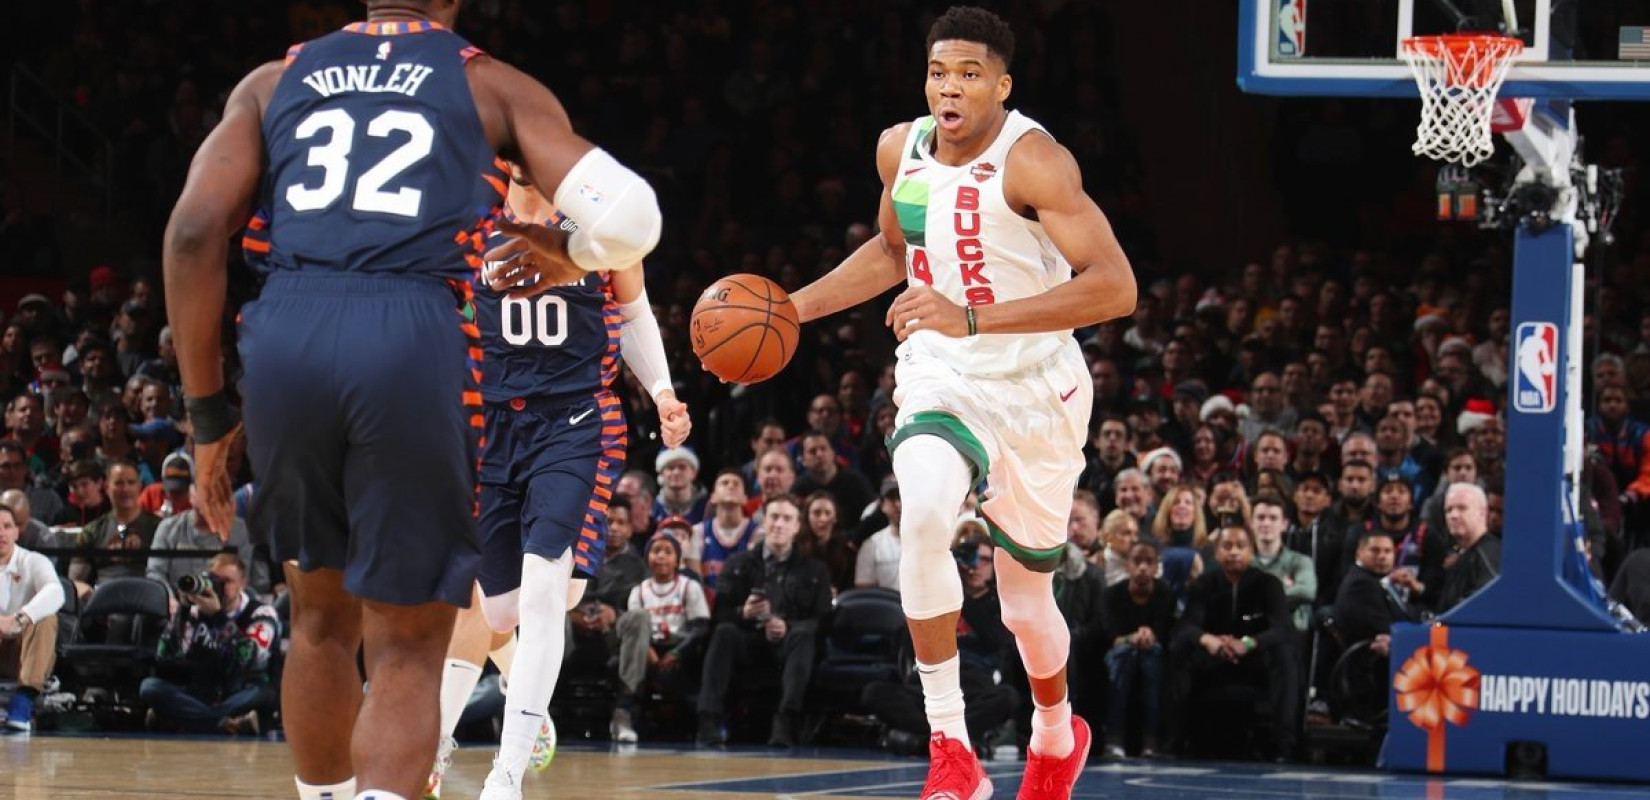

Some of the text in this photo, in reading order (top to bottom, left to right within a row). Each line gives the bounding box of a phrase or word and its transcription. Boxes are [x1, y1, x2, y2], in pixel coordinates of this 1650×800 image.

[302, 63, 434, 97] VONLEH
[286, 108, 434, 217] 32
[953, 186, 995, 307] BUCKS
[501, 295, 568, 345] 00
[1480, 675, 1649, 719] HAPPY HOLIDAYS
